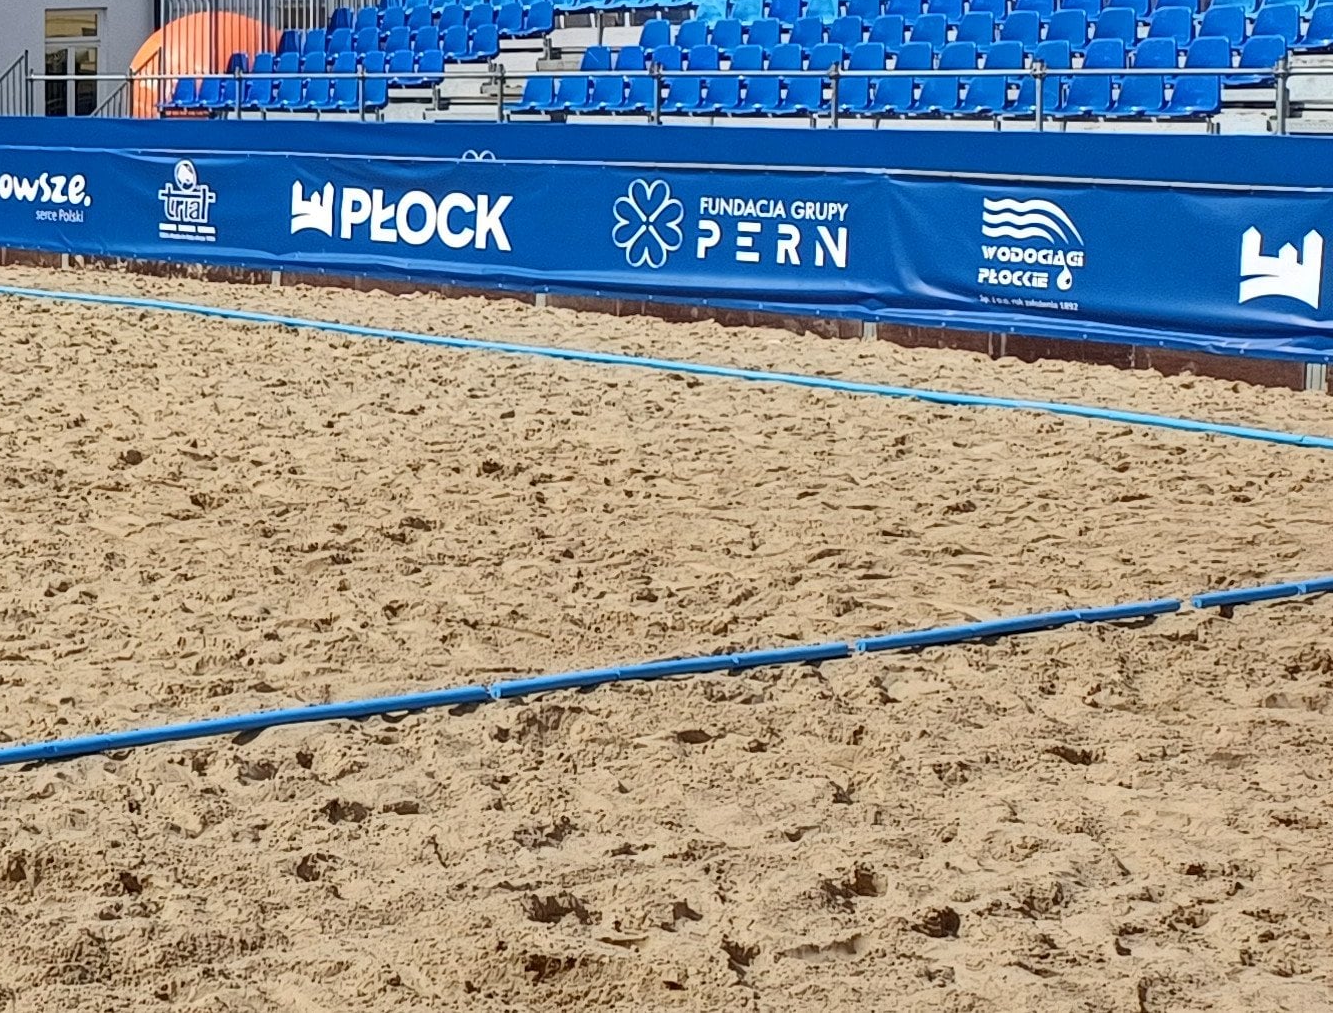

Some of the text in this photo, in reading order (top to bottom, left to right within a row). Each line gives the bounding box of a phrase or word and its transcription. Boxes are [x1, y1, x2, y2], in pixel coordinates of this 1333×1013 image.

[35, 208, 84, 223] serce Polski
[340, 186, 514, 252] PŁOCK
[699, 196, 849, 222] FUNDACJA GRUPY
[696, 219, 848, 268] PERN
